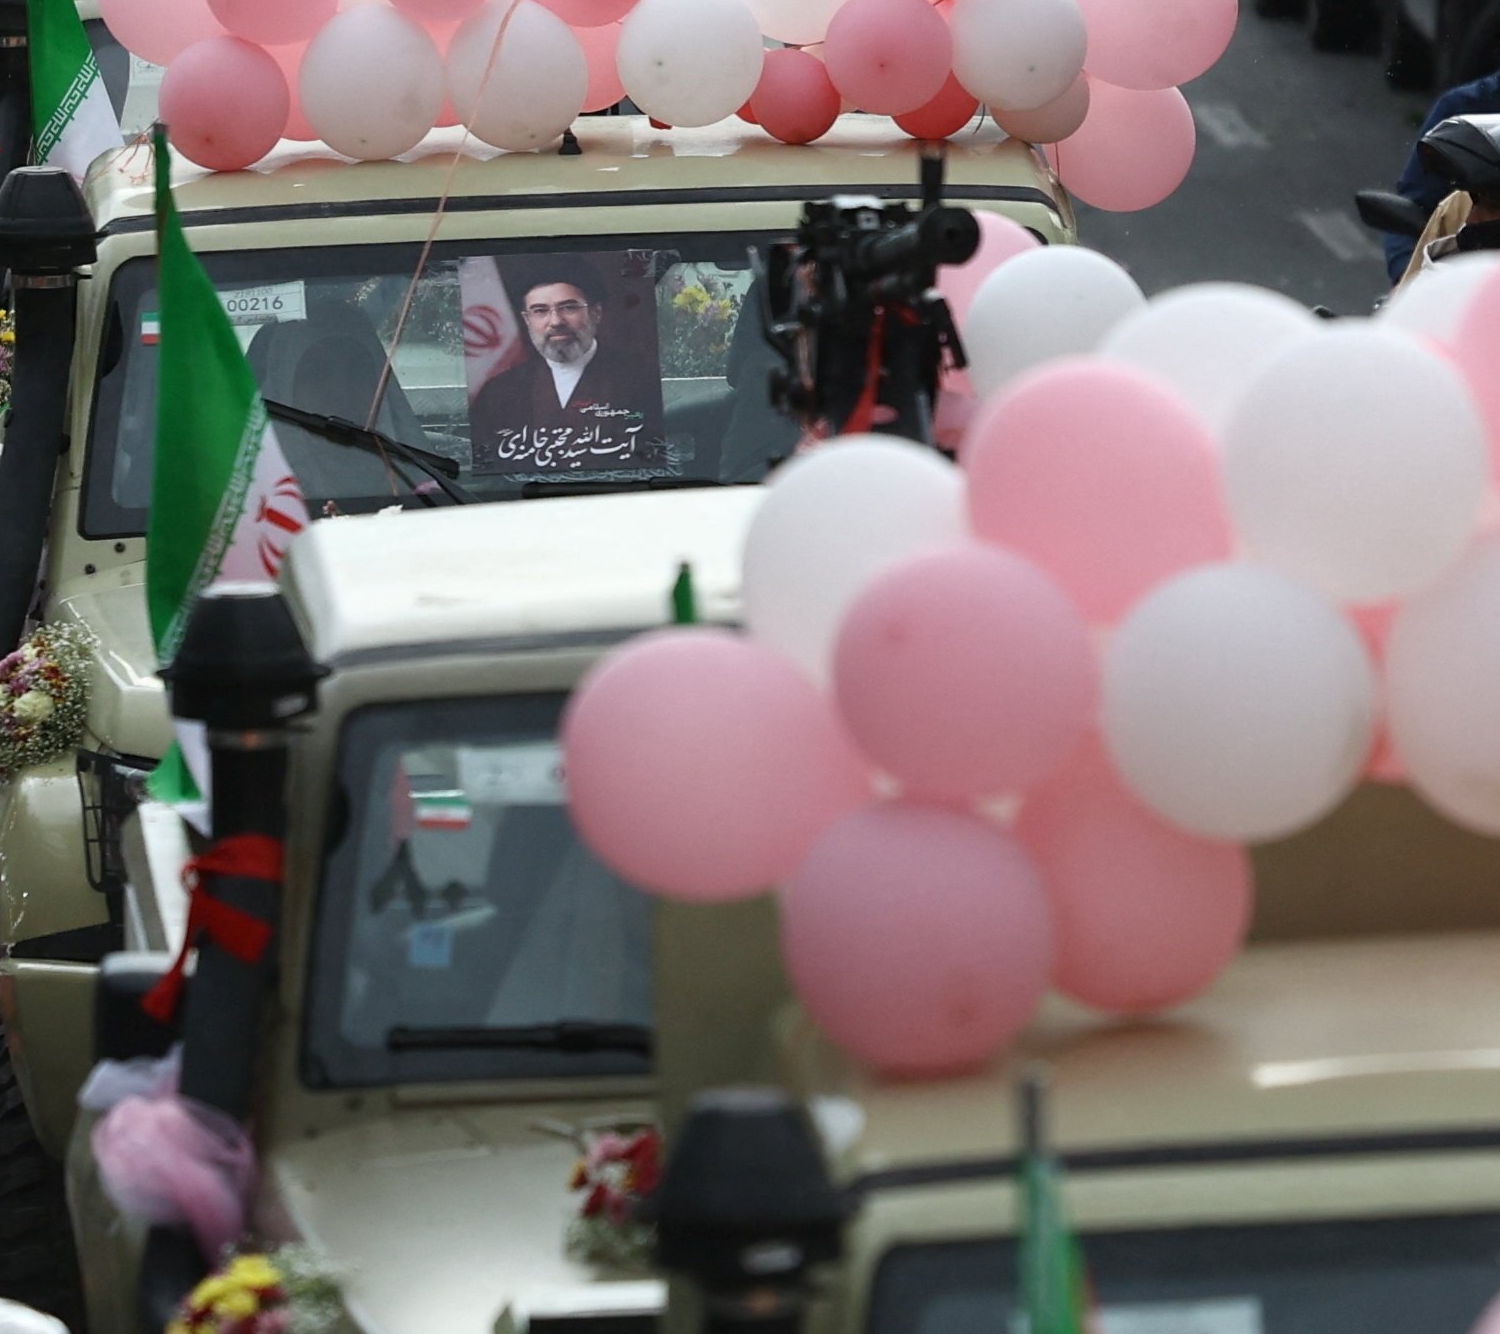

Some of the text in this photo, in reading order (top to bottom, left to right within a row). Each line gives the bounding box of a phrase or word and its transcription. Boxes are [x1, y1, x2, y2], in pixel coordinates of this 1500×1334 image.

[227, 296, 283, 312] 00216
[535, 427, 573, 467] مجتبی
[572, 424, 601, 445] الله
[590, 424, 644, 460] آیت
